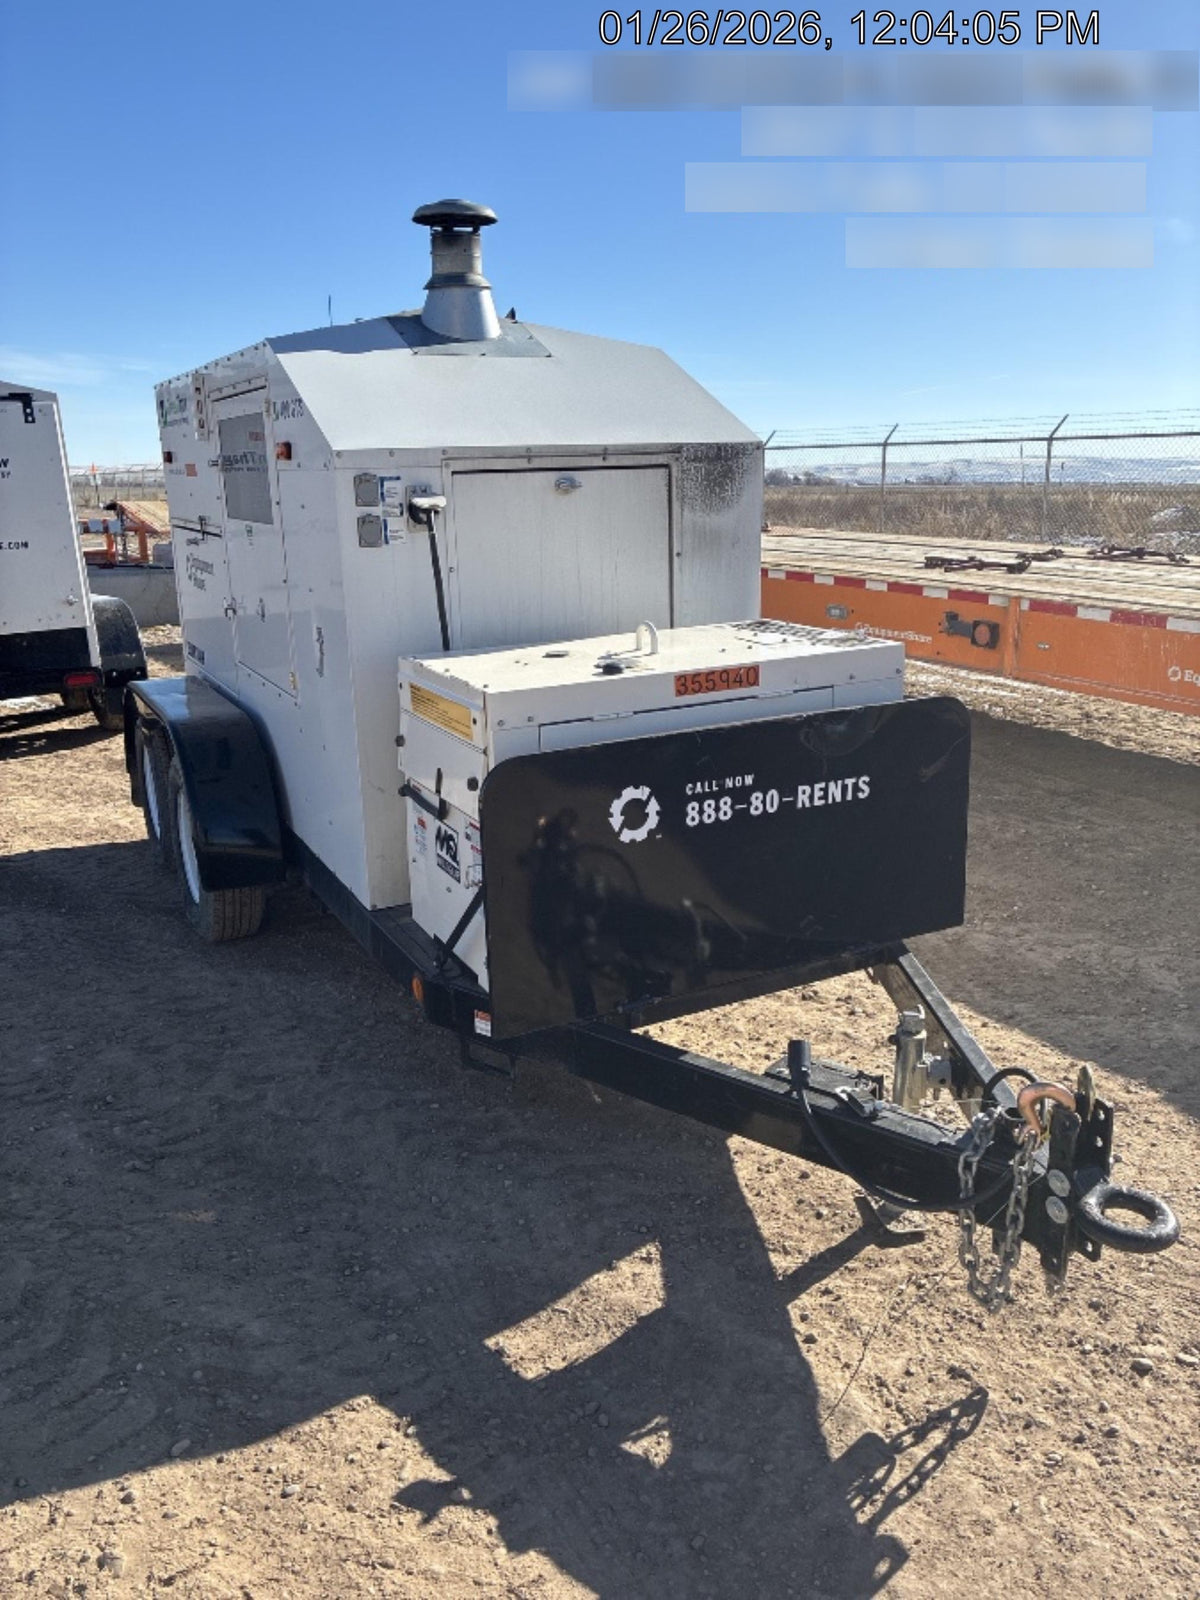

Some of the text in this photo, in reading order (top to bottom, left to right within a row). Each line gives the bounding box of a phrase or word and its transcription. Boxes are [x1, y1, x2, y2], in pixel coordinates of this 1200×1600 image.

[675, 666, 759, 697] 355940
[685, 773, 755, 796] CALL NOW
[685, 775, 871, 828] 888-80-RENTS
